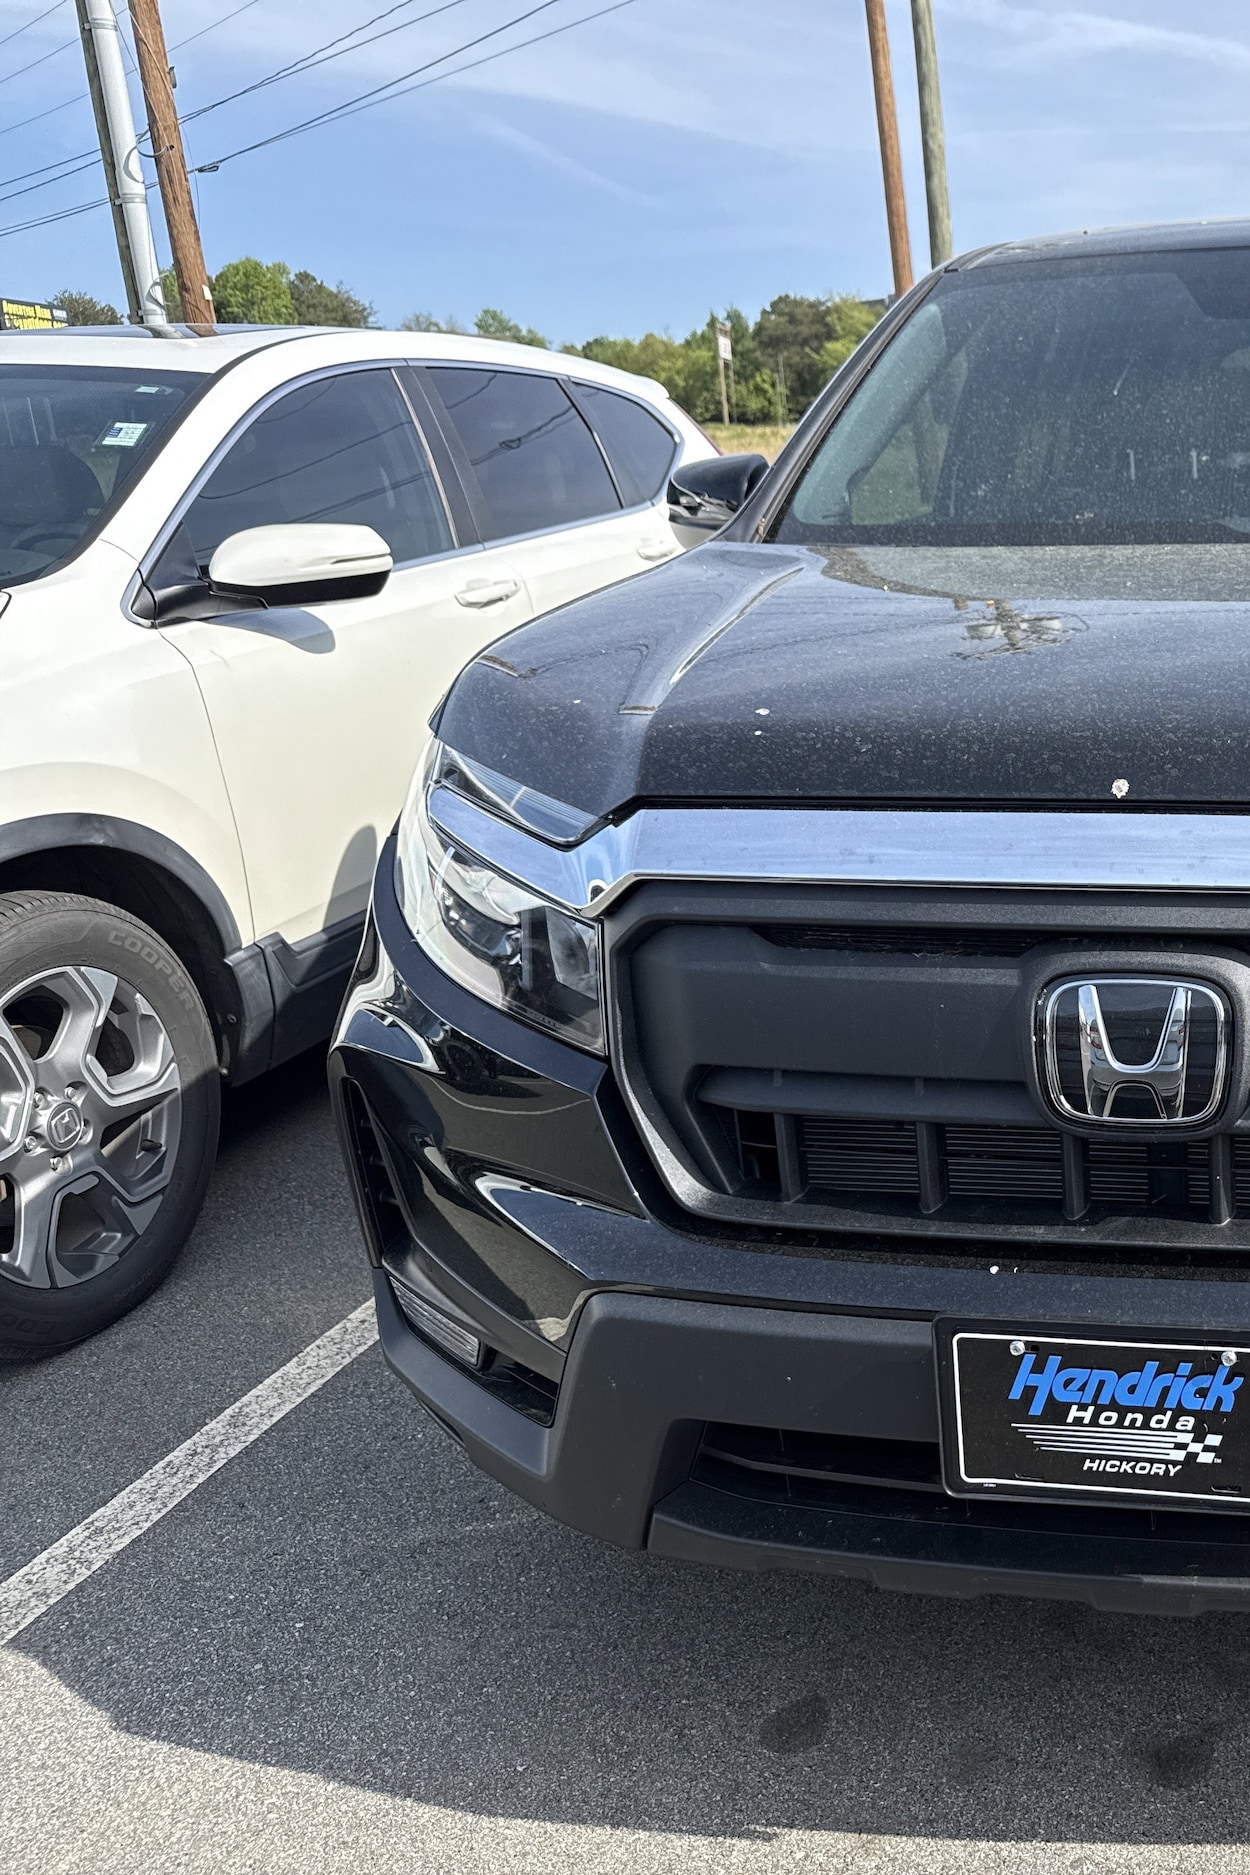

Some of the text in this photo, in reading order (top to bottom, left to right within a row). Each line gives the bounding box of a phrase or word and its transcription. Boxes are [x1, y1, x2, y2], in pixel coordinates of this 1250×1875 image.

[107, 930, 195, 1011] COOPER
[1008, 1353, 1245, 1416] Hendrick
[1066, 1405, 1196, 1431] Honda
[1083, 1458, 1182, 1477] HICKORY
